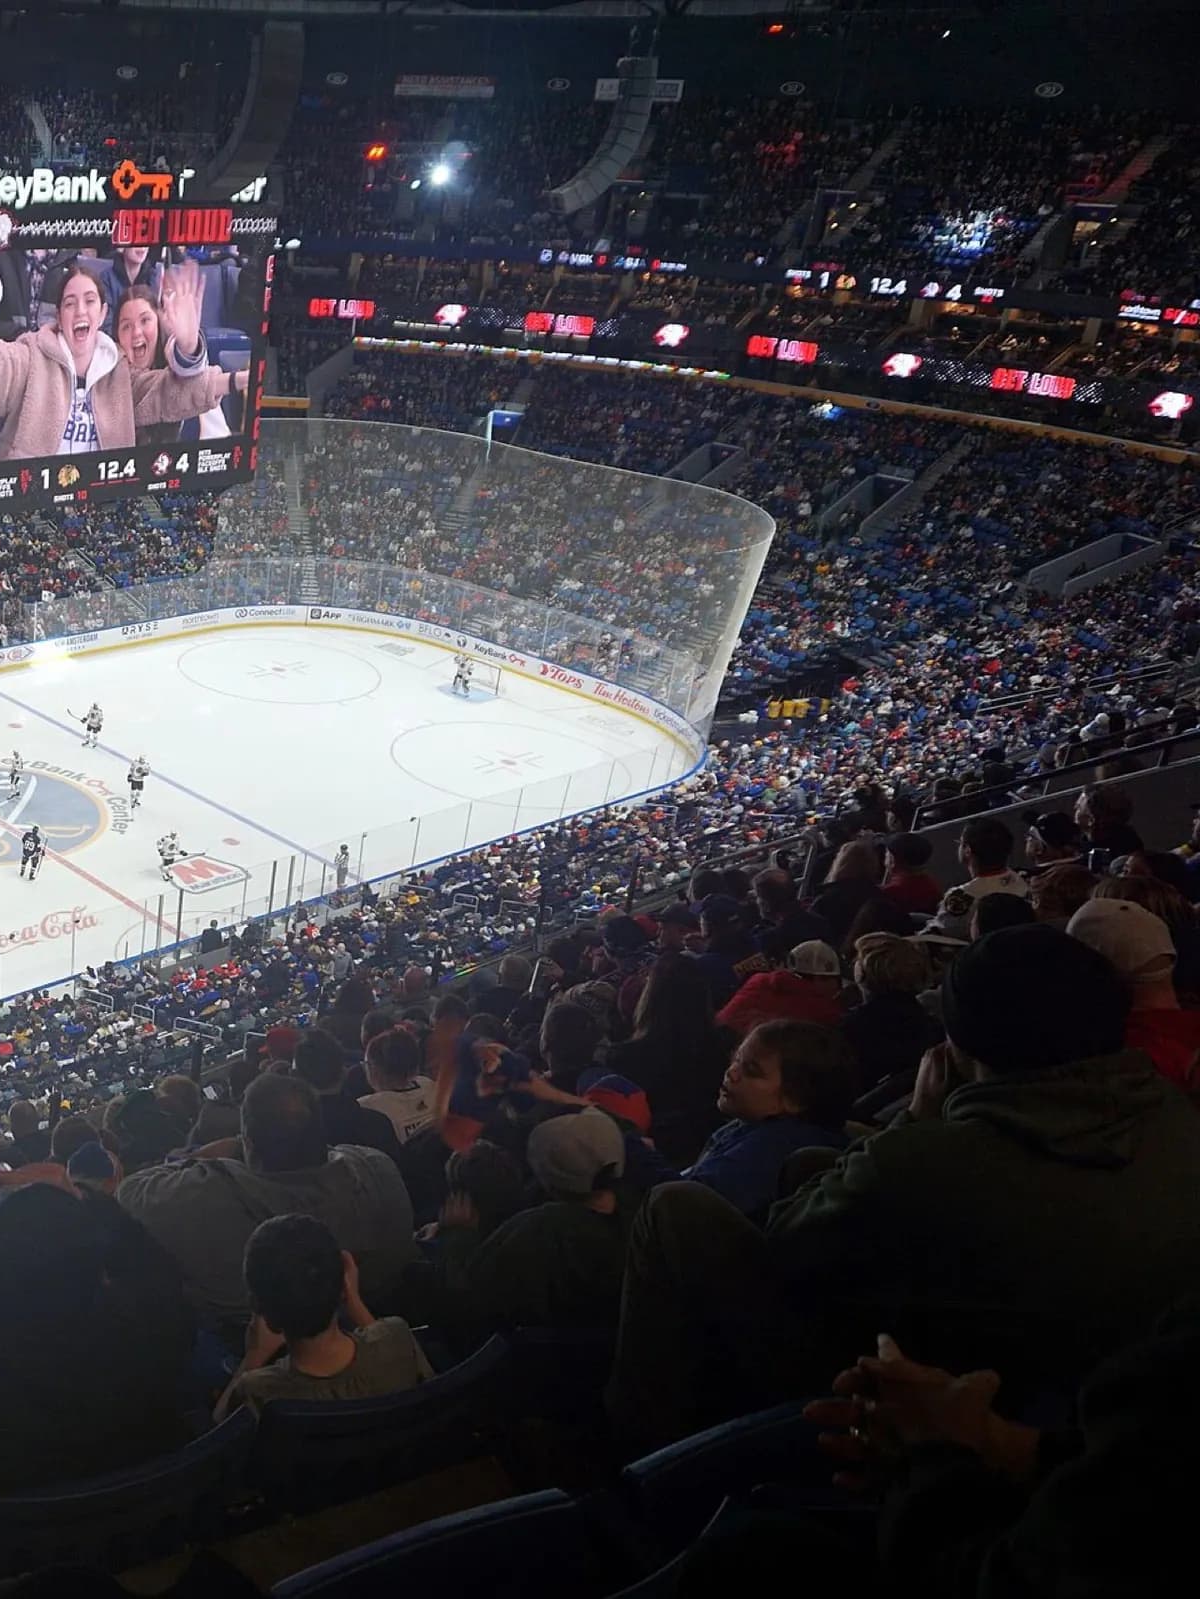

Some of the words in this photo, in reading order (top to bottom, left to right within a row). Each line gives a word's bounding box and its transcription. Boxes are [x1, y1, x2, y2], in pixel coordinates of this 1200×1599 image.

[112, 209, 164, 244] GET
[169, 209, 232, 242] LOUD
[820, 272, 829, 288] 1
[870, 278, 906, 294] 12.4
[946, 284, 961, 300] 4
[41, 468, 50, 489] 1
[98, 459, 136, 480] 12.4
[176, 453, 189, 473] 4
[168, 479, 180, 488] 22
[419, 623, 441, 637] BFLO
[474, 643, 507, 660] KeyBank
[593, 681, 612, 699] Tim
[613, 688, 650, 715] Hortons
[107, 794, 134, 834] Center
